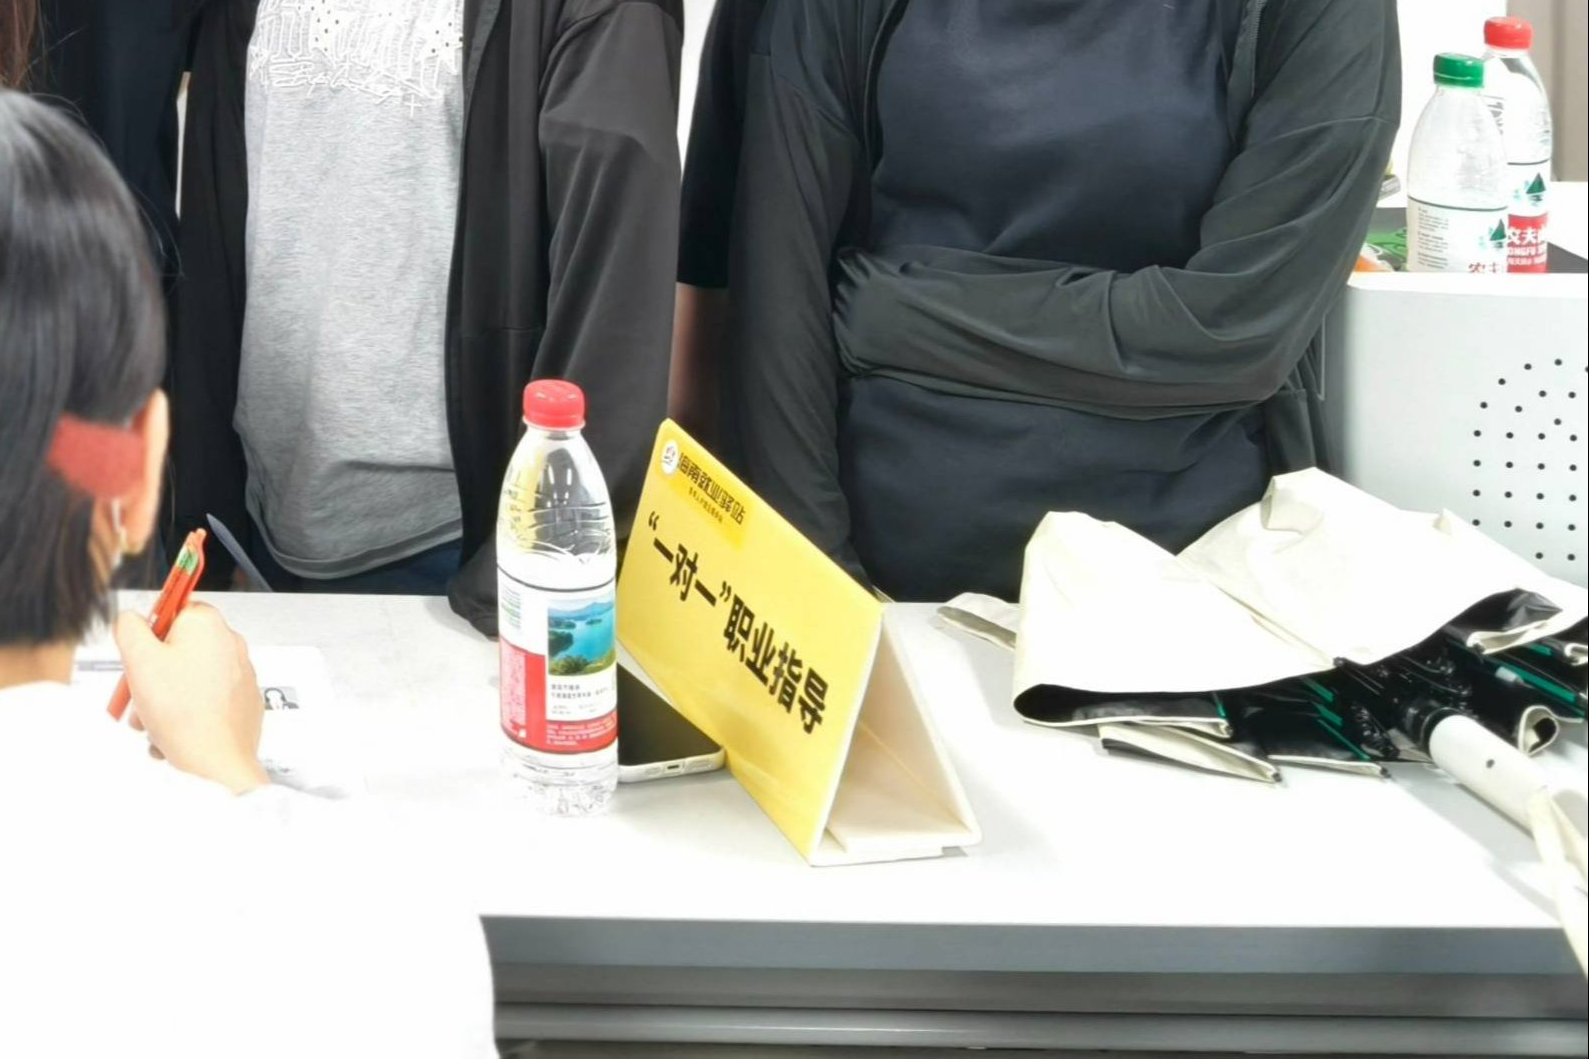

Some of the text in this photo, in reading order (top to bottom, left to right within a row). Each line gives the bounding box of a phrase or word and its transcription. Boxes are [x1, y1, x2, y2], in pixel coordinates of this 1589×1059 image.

[648, 511, 829, 734] “一对一”职业指导
